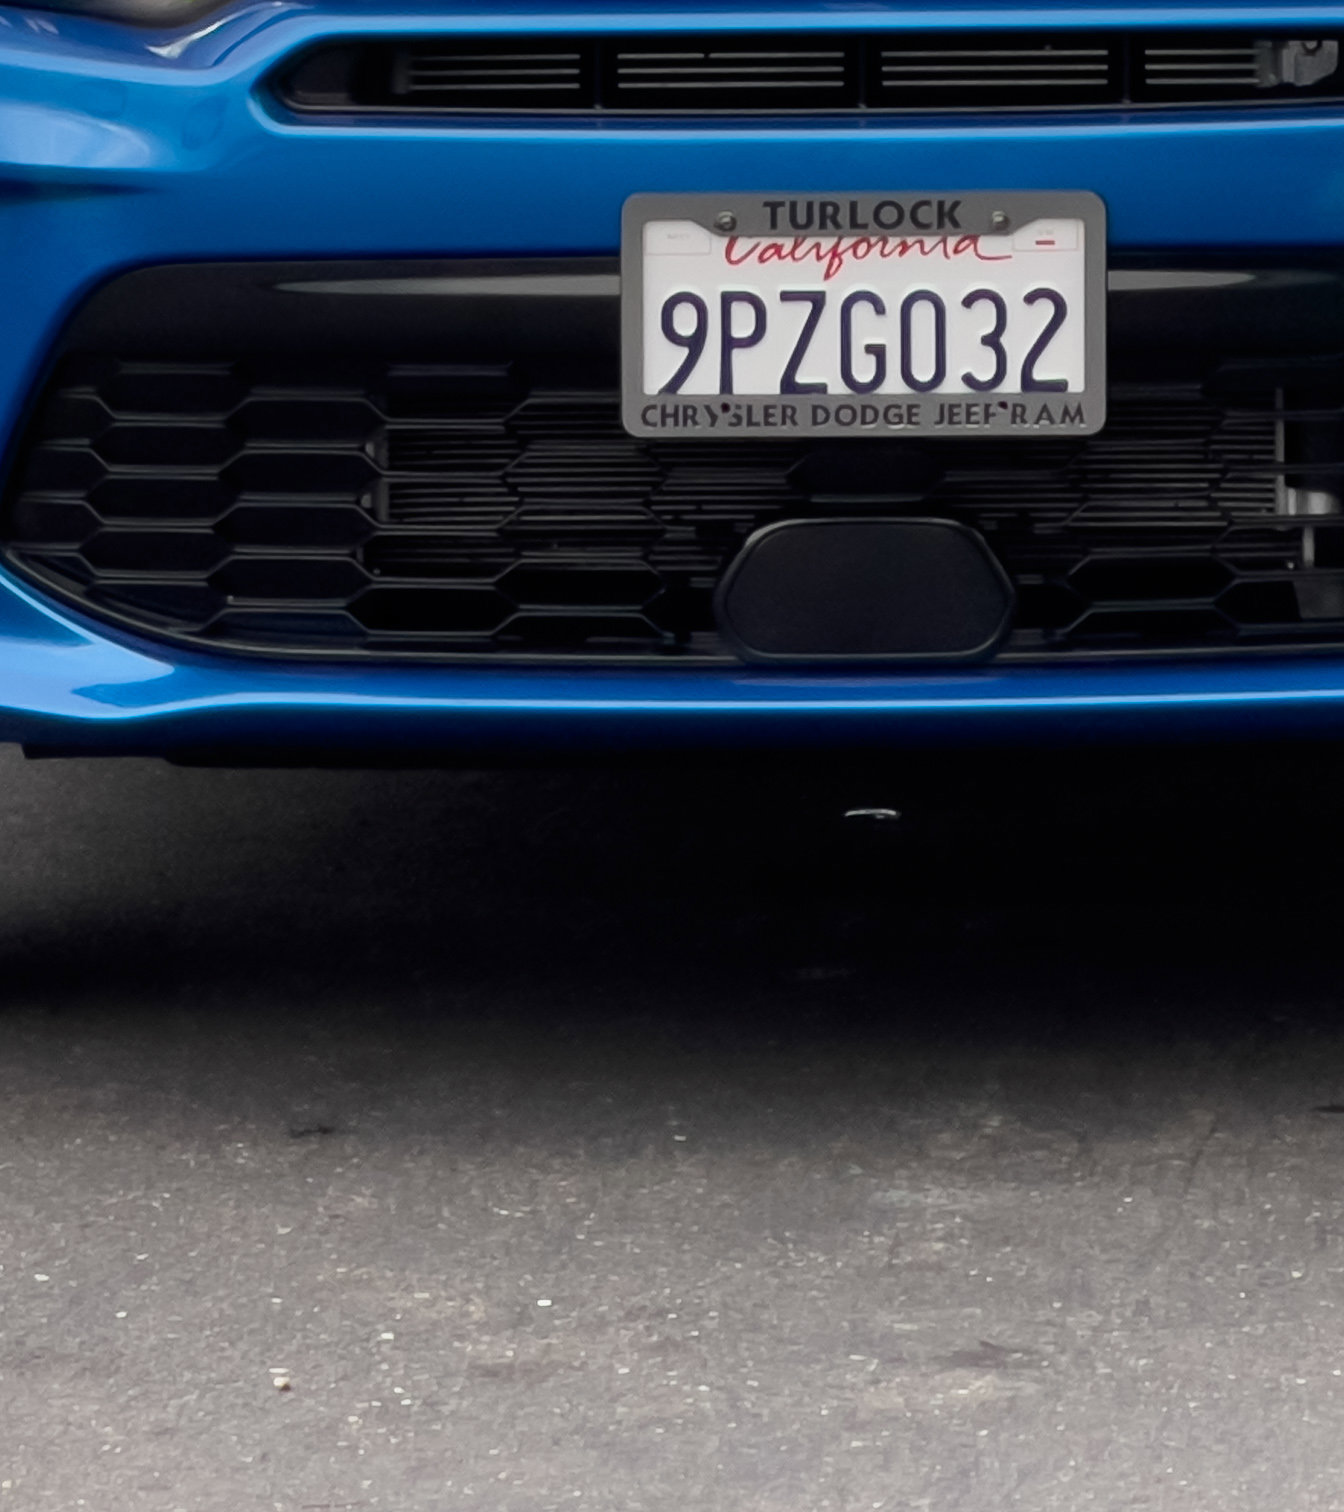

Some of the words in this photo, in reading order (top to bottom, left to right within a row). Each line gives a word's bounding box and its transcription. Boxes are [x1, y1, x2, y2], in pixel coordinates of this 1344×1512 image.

[762, 200, 963, 230] TURLOCK
[723, 234, 1013, 280] California
[657, 286, 1070, 395] 9PZG032
[641, 403, 799, 428] CHRYSLER
[811, 403, 923, 427] DODGE
[1010, 401, 1086, 426] RAM
